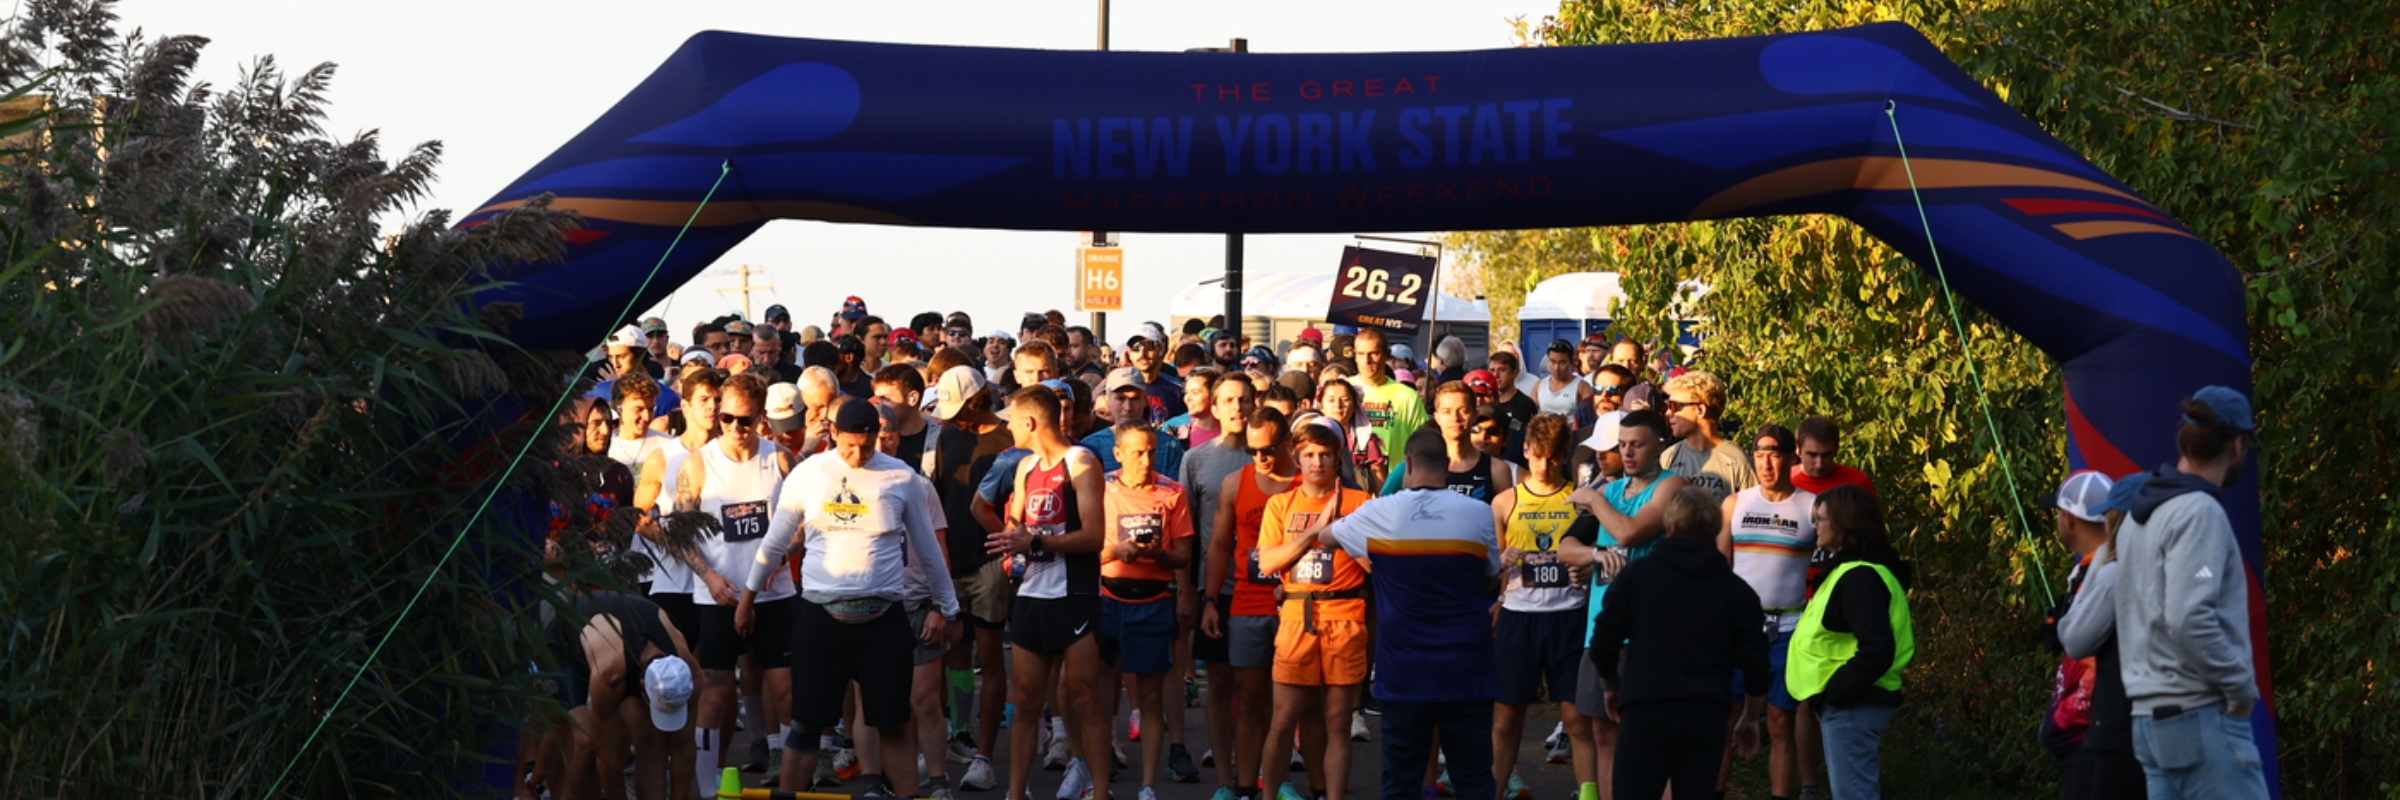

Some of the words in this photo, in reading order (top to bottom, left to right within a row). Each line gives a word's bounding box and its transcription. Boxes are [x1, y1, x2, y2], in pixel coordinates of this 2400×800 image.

[1190, 81, 1272, 104] THE
[1299, 75, 1443, 102] GREAT
[1051, 115, 1195, 181] NEW
[1213, 107, 1379, 178] YORK
[1397, 96, 1575, 170] STATE
[1062, 188, 1315, 215] MARATHON
[1337, 175, 1554, 209] WEEKEND
[1086, 253, 1120, 263] ORANGE
[1087, 268, 1119, 291] H6
[1341, 264, 1422, 306] 26.2
[1357, 314, 1386, 326] GREAT
[1384, 318, 1404, 330] NYS
[734, 516, 760, 536] 175
[1296, 561, 1323, 579] 268
[1533, 566, 1559, 583] 180
